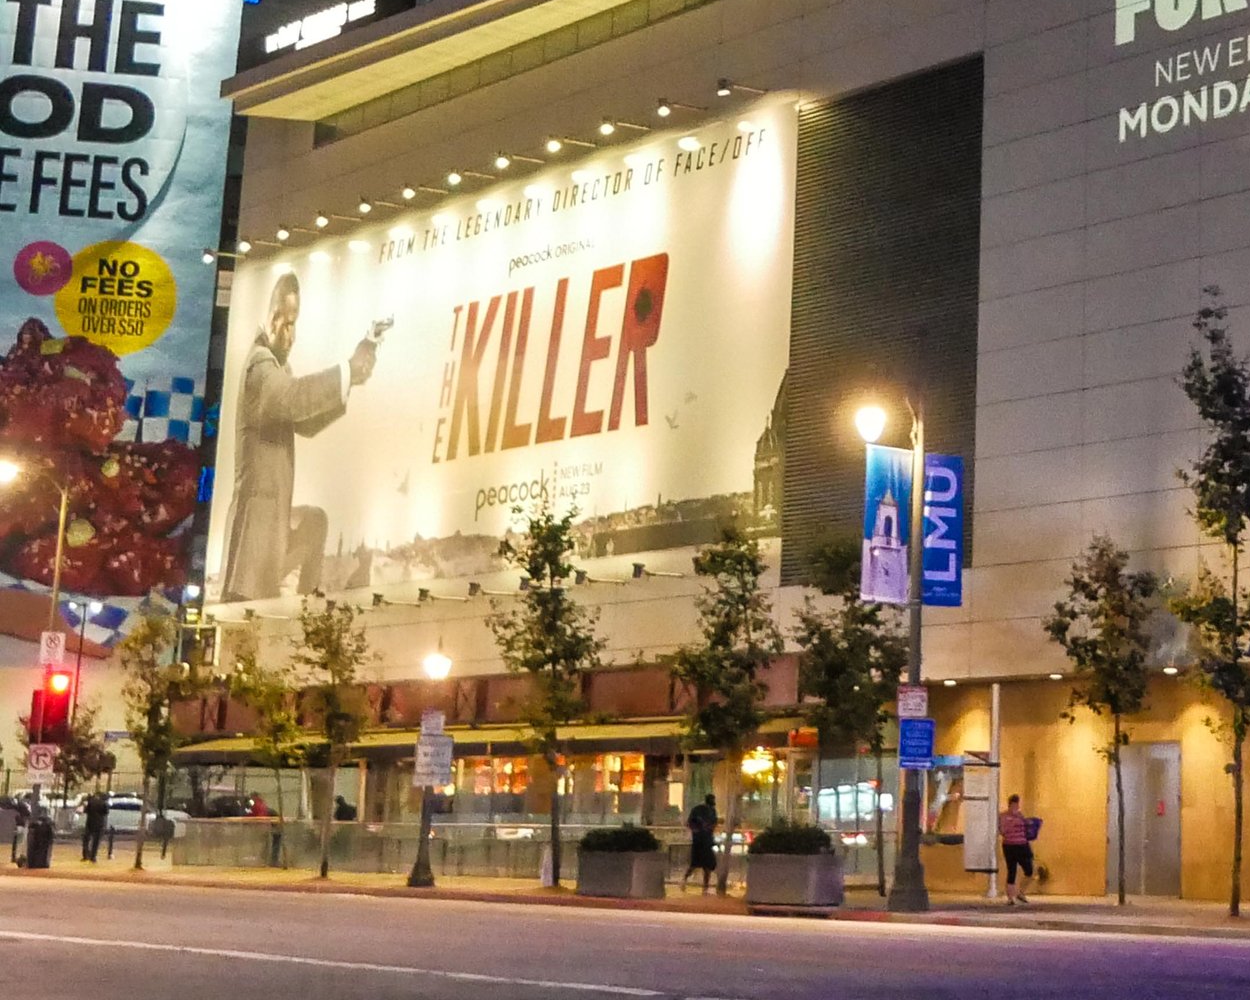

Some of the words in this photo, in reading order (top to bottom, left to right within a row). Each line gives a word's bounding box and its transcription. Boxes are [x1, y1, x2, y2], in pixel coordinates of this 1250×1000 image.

[1155, 43, 1221, 87] NEW
[29, 150, 149, 221] FEES
[378, 234, 416, 264] FROM
[423, 224, 448, 251] THE
[456, 199, 543, 241] LEGENDARY
[552, 168, 634, 212] DIRECTOR
[644, 158, 665, 185] OF
[674, 128, 766, 177] FACE/OFF
[80, 276, 153, 298] FEES
[98, 259, 140, 279] NO
[78, 298, 97, 315] ON
[100, 298, 152, 318] ORDERS
[82, 316, 115, 335] OVER
[118, 318, 144, 337] $50
[446, 252, 669, 461] KILLER
[475, 469, 549, 521] peacock
[923, 466, 958, 581] LMU
